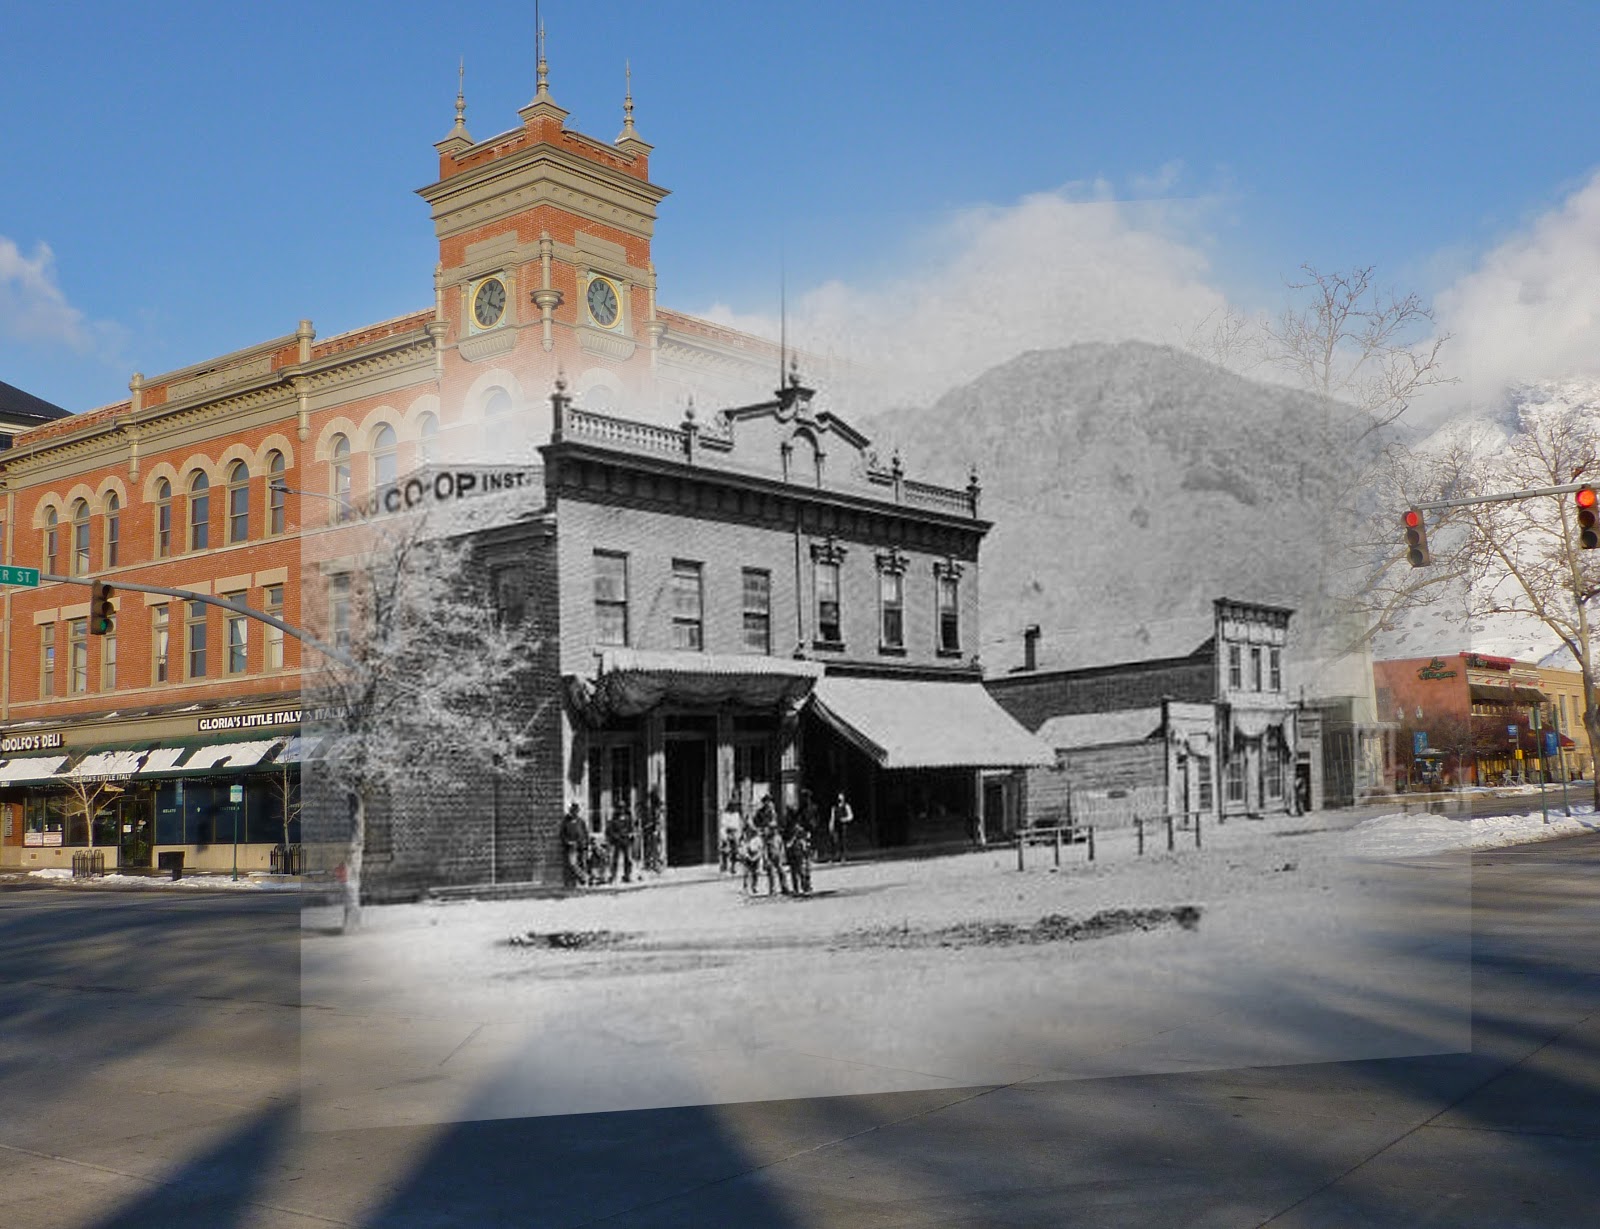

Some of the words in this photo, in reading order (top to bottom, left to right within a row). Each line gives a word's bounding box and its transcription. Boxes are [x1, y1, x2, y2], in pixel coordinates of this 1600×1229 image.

[0, 569, 9, 581] R
[199, 716, 241, 730] GLORIA'S
[242, 713, 273, 727] LITTLE
[274, 710, 302, 724] ITALY
[41, 733, 60, 748] DELI
